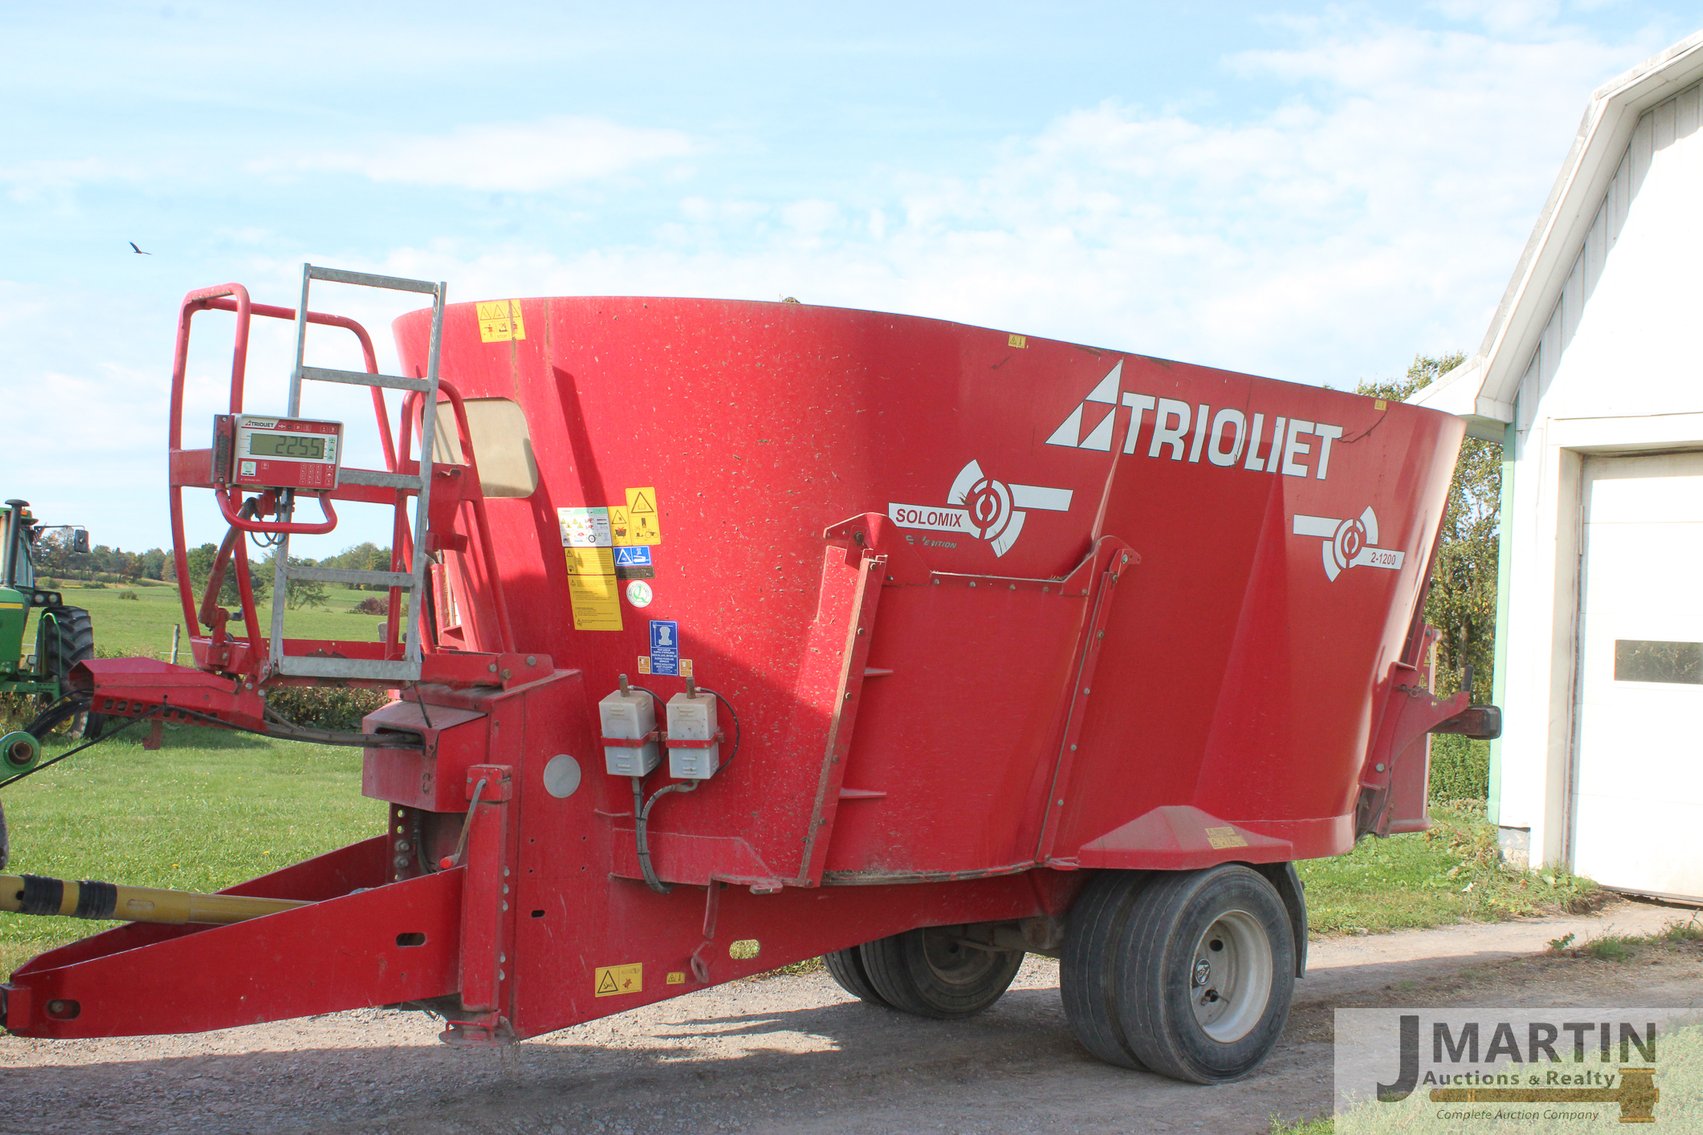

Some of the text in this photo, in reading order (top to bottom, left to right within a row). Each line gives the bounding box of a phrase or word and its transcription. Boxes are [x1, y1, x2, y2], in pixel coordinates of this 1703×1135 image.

[1122, 391, 1343, 480] TRIOLIET
[275, 436, 320, 456] 2255
[895, 508, 963, 528] SOLOMIX
[1371, 552, 1396, 565] 2-1200
